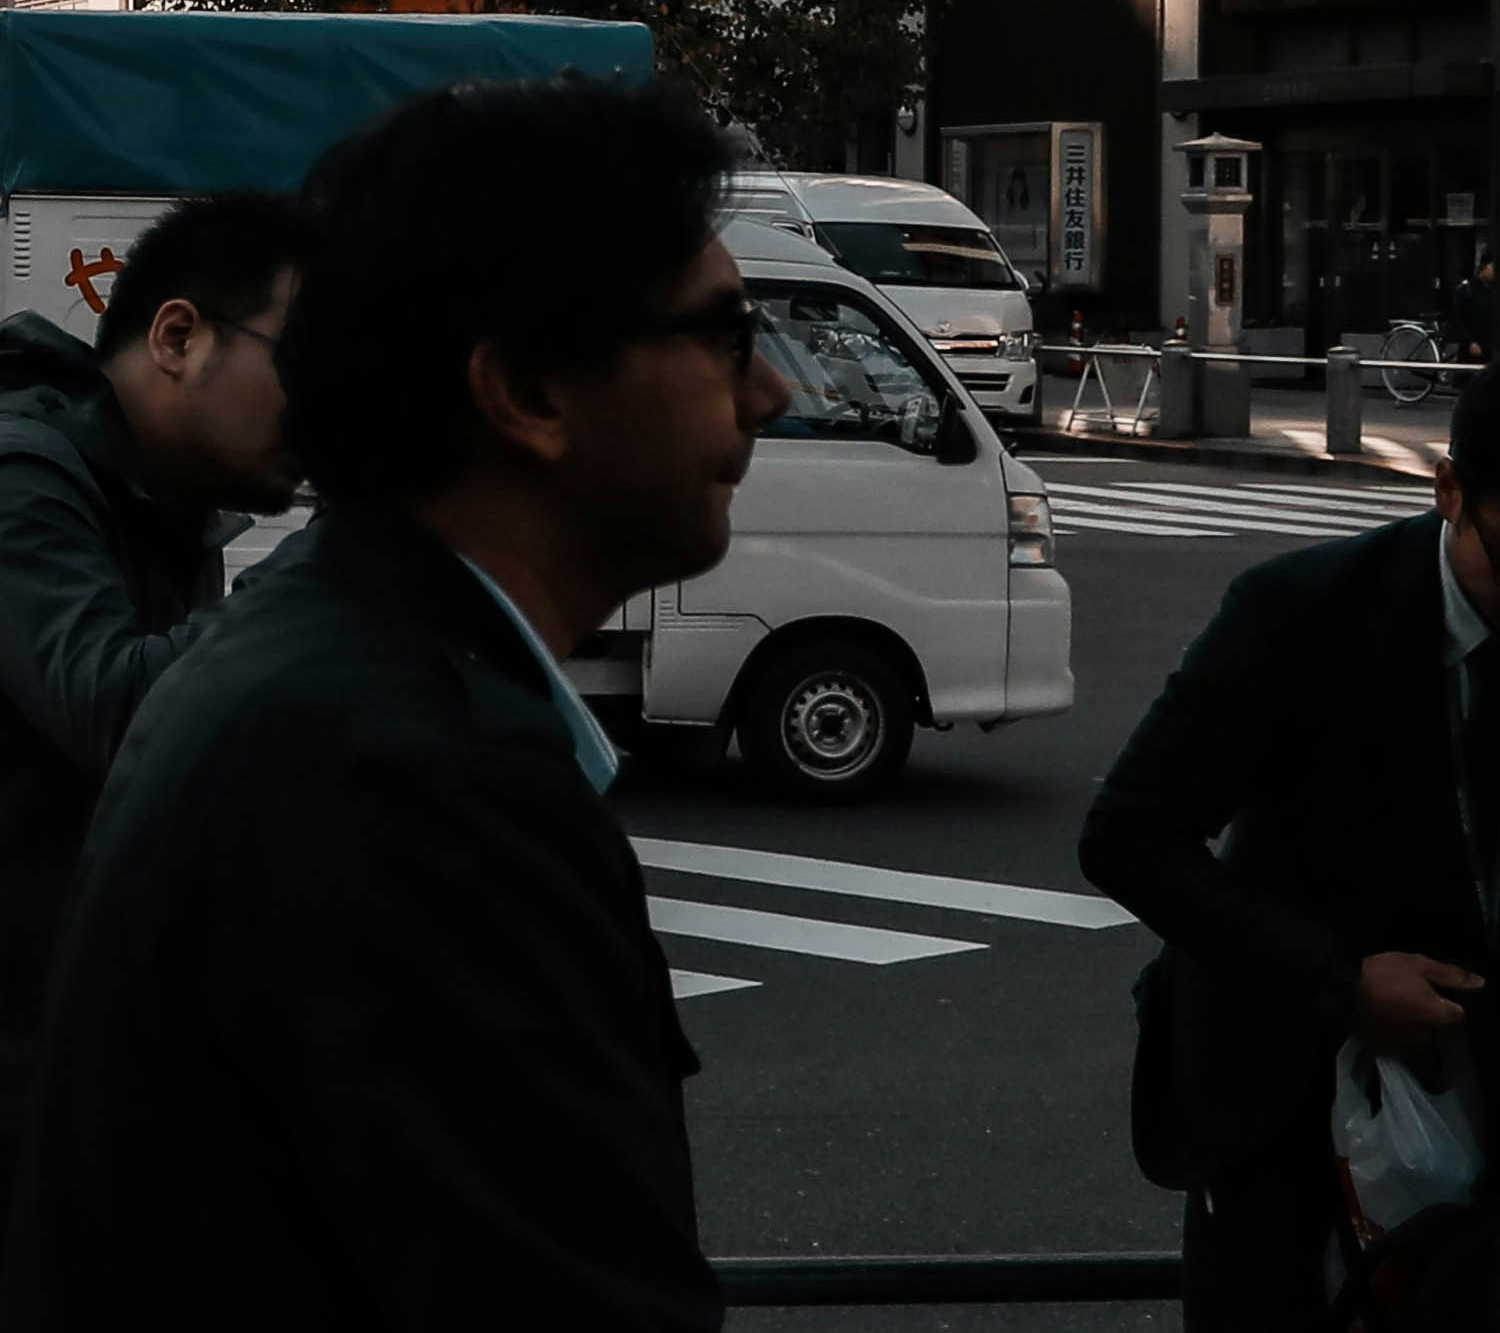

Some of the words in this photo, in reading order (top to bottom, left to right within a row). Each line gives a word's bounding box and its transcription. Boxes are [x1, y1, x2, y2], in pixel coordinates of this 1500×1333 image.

[1065, 145, 1086, 271] 三井住友銀行
